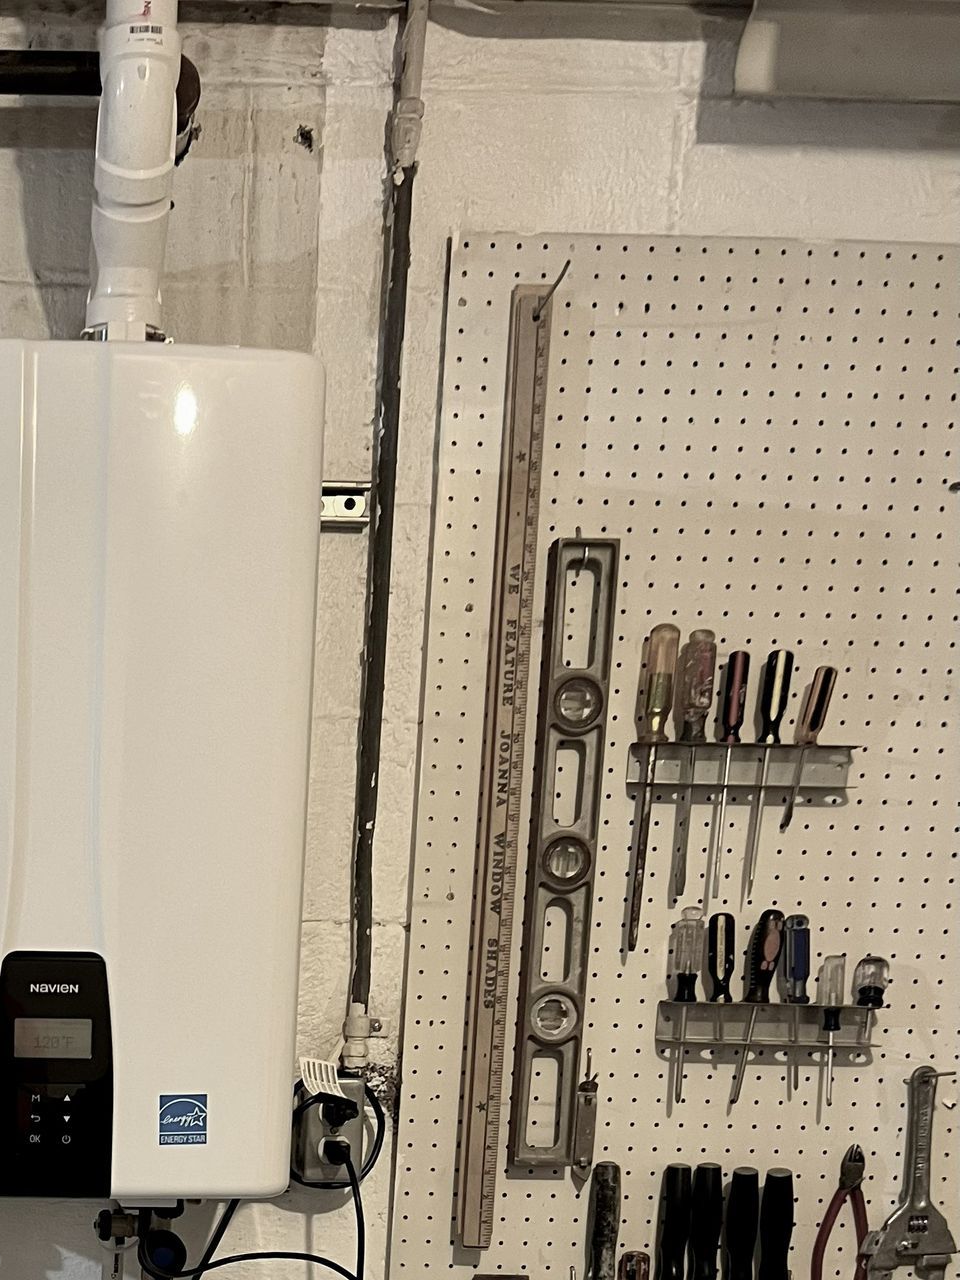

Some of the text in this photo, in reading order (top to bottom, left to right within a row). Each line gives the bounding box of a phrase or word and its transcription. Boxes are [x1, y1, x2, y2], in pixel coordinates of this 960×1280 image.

[483, 563, 521, 1010] WE FEATURE JOANNA WINDOW SHADES
[29, 1134, 41, 1143] OK
[161, 1135, 206, 1144] ENERGY STAR
